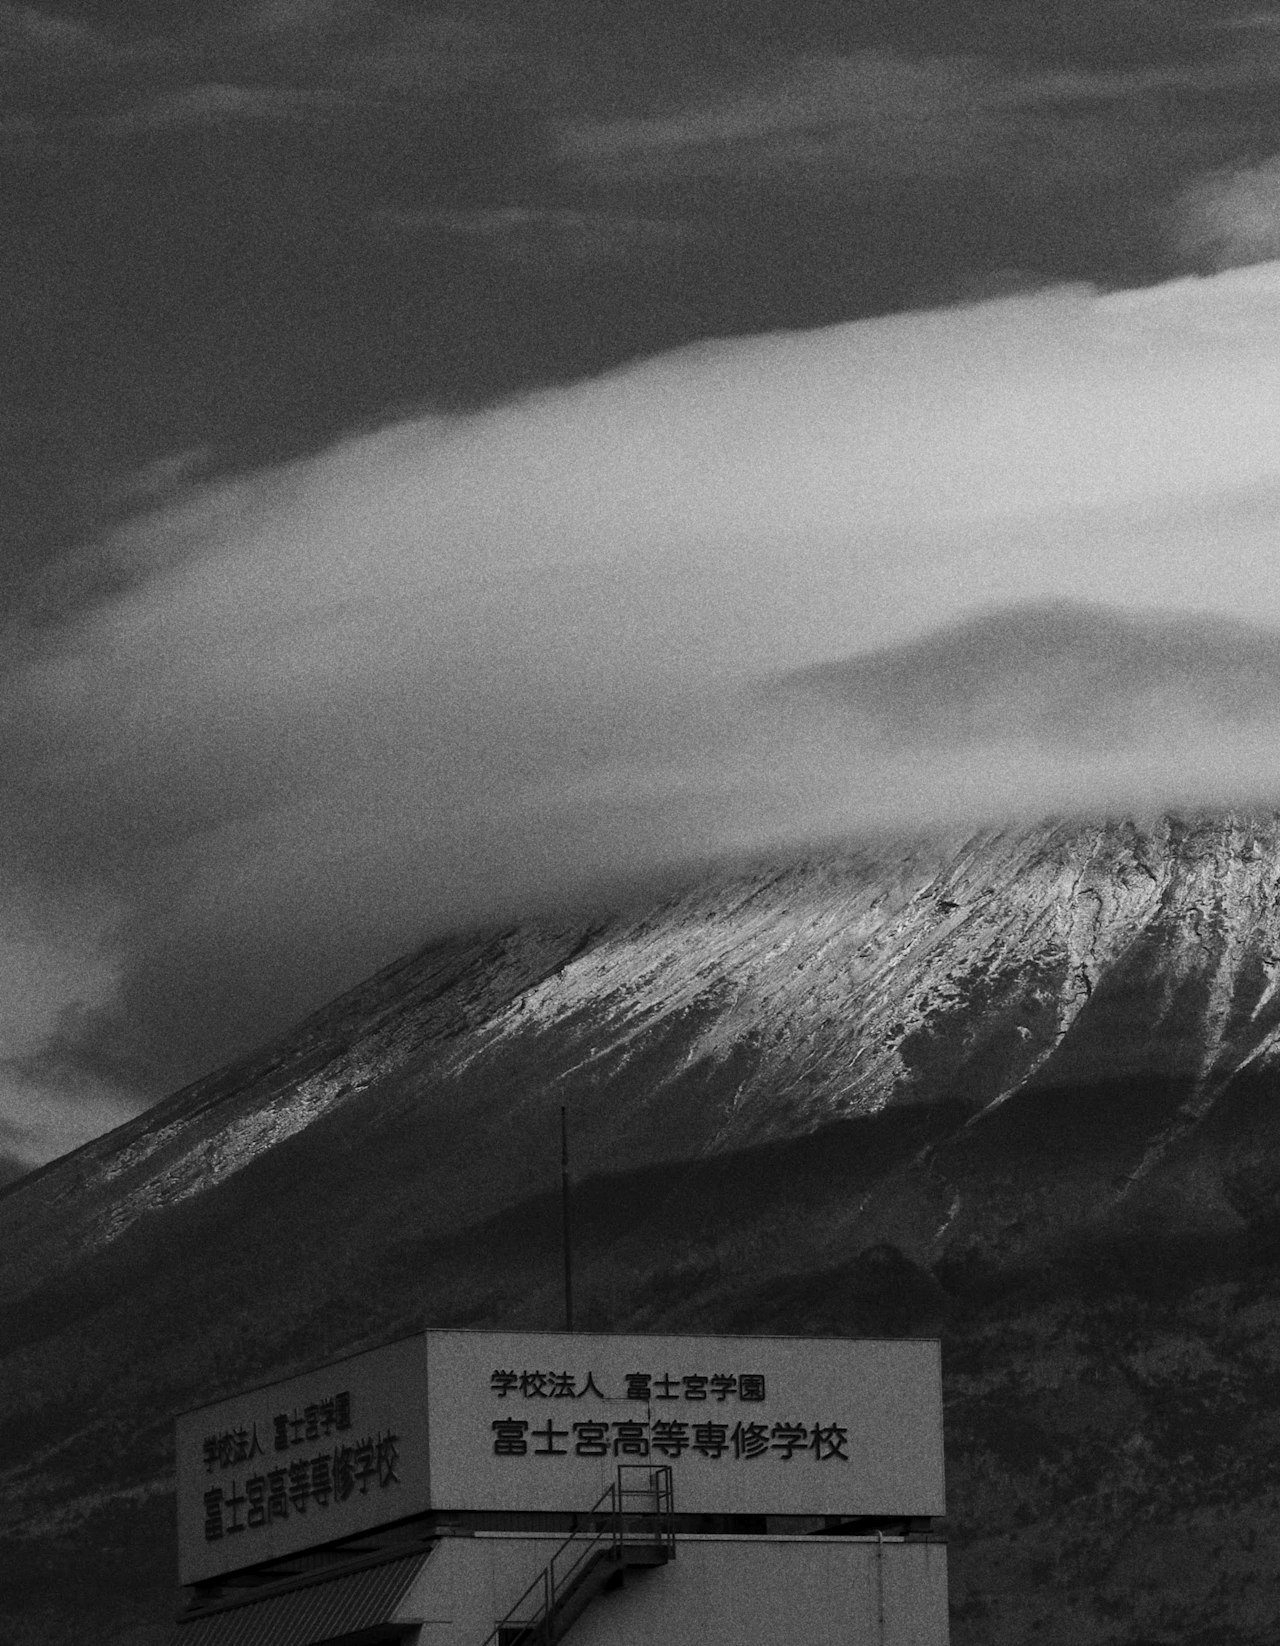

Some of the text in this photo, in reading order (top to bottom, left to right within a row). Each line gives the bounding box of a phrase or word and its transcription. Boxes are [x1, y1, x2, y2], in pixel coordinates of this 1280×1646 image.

[490, 1370, 765, 1402] 学校法人 富士宮学園
[203, 1421, 263, 1473] 学校法人
[491, 1417, 848, 1461] 富士宮高等専修学校
[203, 1430, 400, 1541] 富士宮高等専修学校
